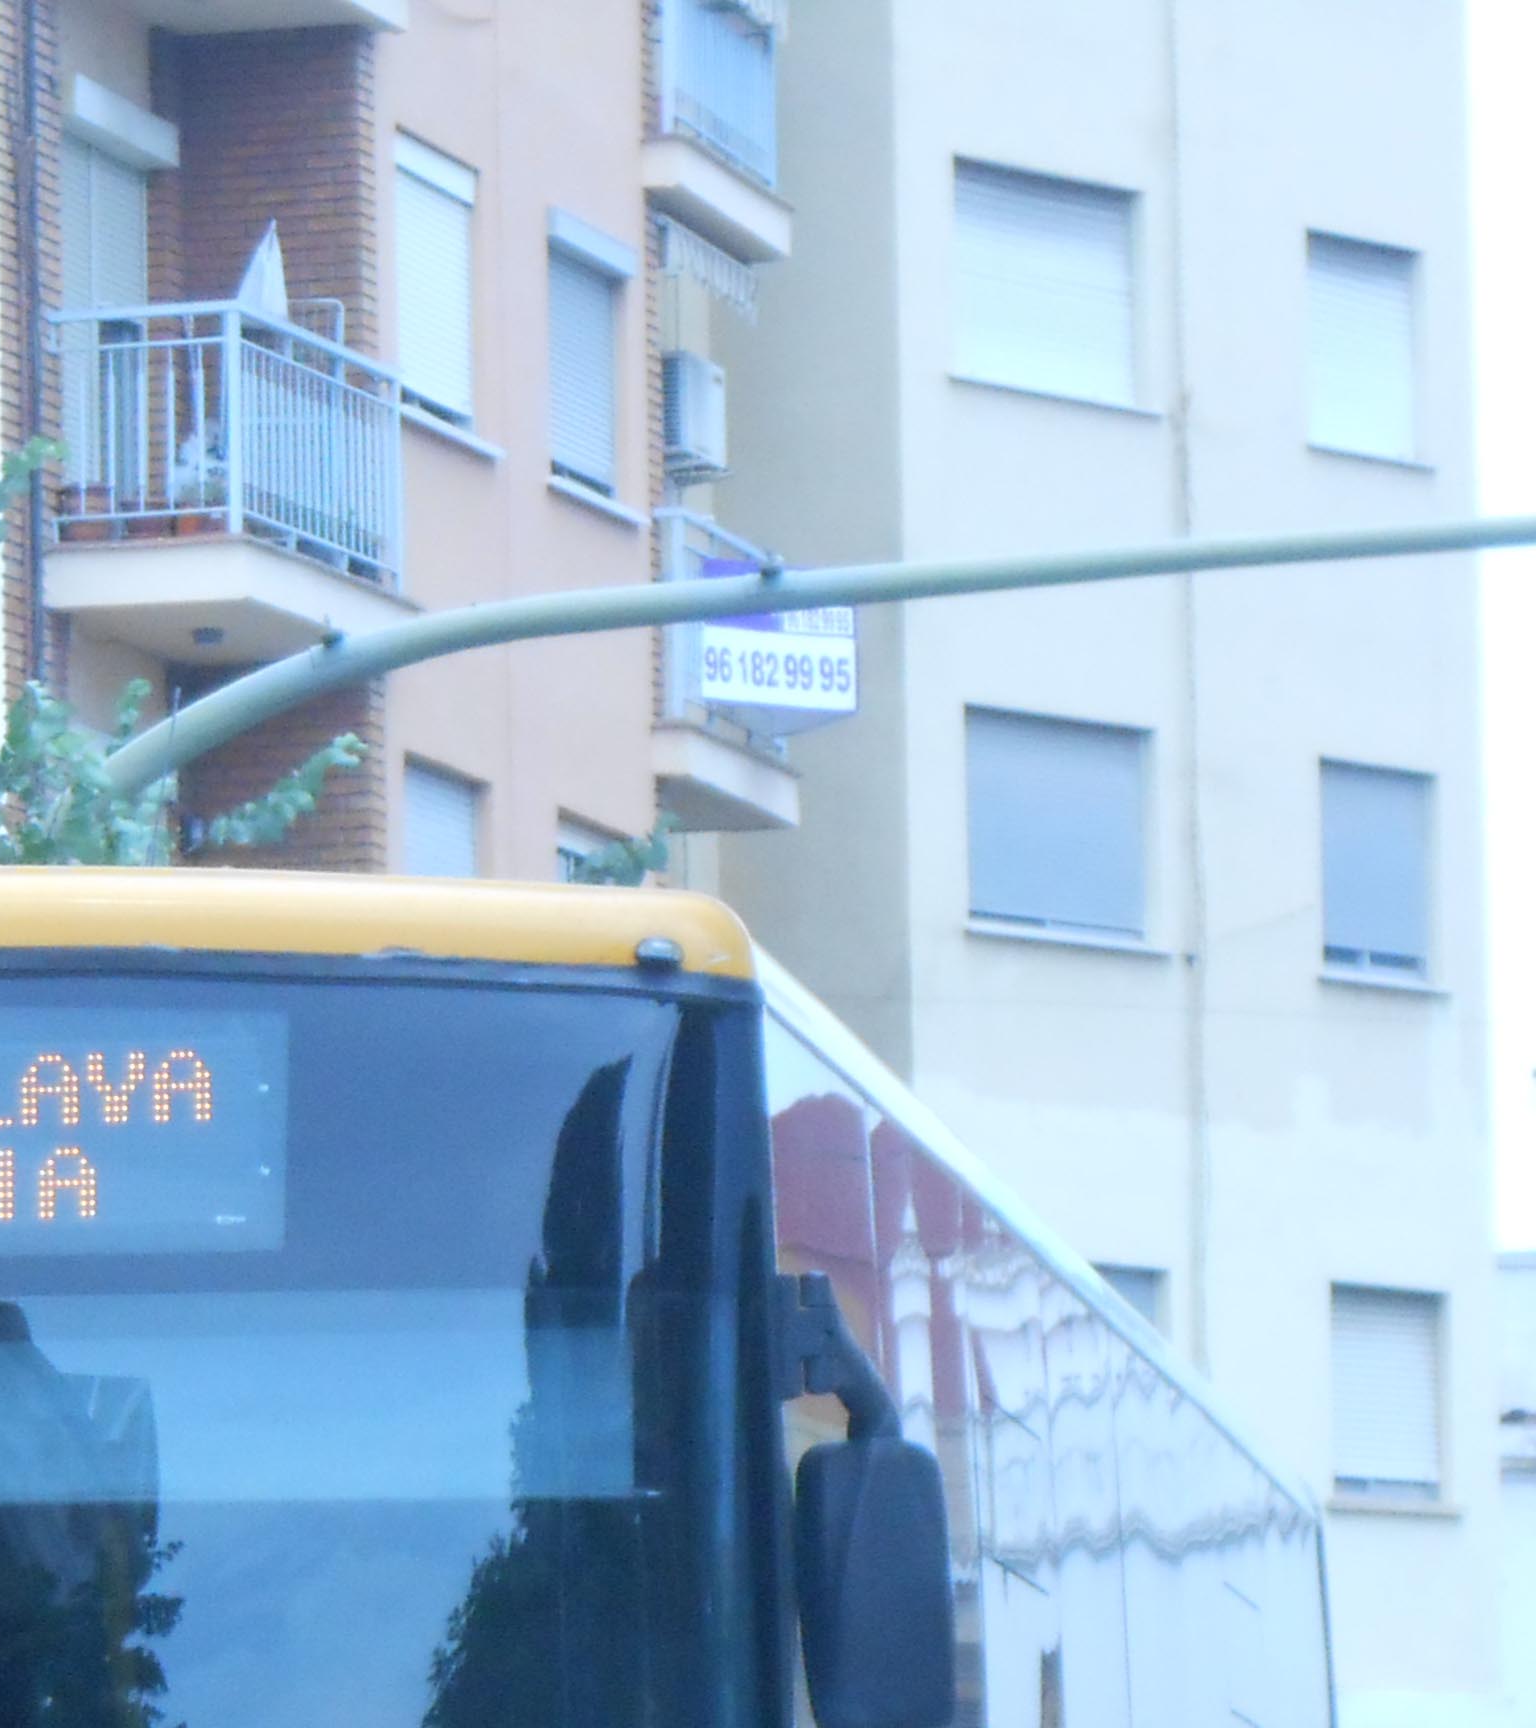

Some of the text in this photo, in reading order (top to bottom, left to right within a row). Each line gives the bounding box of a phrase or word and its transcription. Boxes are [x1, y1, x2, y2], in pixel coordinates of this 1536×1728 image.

[704, 646, 851, 693] 96 182 99 95
